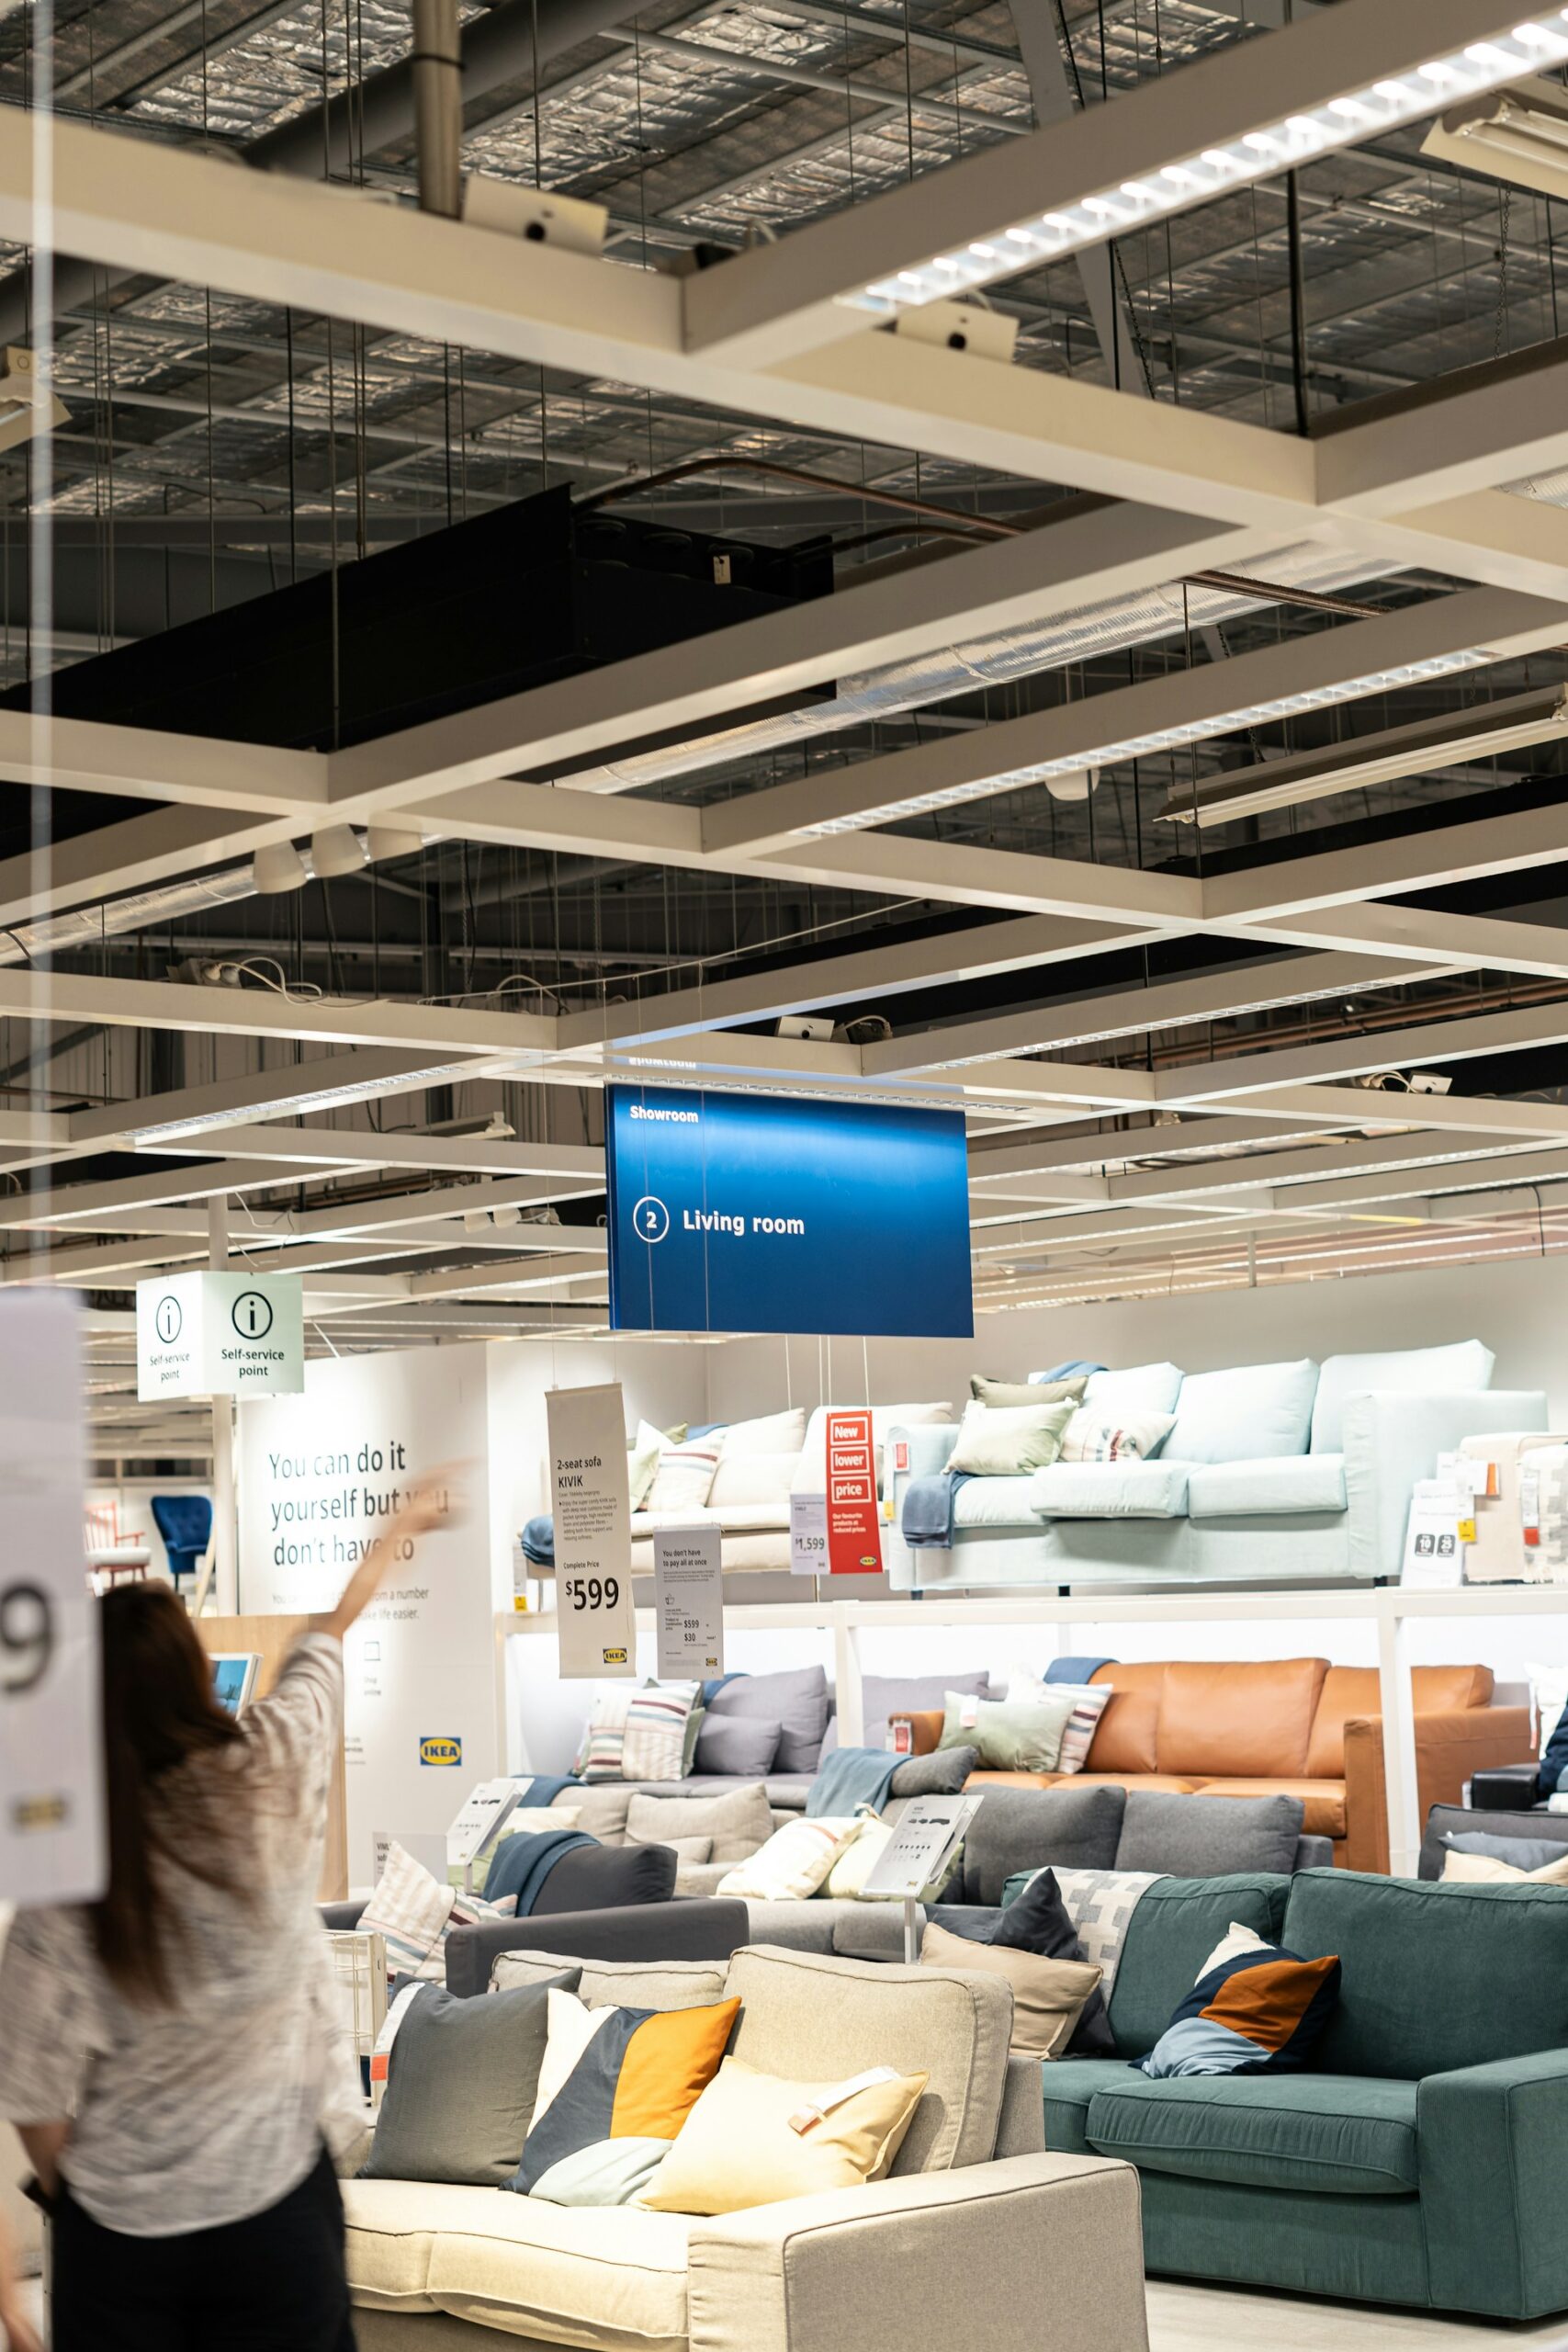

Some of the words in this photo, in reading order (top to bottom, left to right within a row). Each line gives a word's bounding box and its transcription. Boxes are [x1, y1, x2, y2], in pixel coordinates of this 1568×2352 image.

[630, 1106, 698, 1123] Showroom
[646, 1212, 657, 1229] 2
[683, 1210, 744, 1236] Living
[753, 1217, 805, 1235] room
[150, 1353, 190, 1366] Self-service
[221, 1349, 285, 1360] Self-service
[161, 1369, 180, 1383] point
[239, 1365, 268, 1378] point
[835, 1426, 858, 1439] New
[269, 1453, 305, 1479] You
[314, 1453, 349, 1476] can
[358, 1443, 383, 1473] do
[391, 1440, 406, 1470] it
[557, 1459, 582, 1470] 2-seat
[584, 1456, 601, 1467] sofa
[835, 1453, 863, 1466] lower
[558, 1476, 583, 1488] KIVIK
[836, 1483, 862, 1499] price
[272, 1488, 357, 1532] yourself
[364, 1487, 400, 1517] but
[275, 1537, 324, 1566] don't
[394, 1535, 414, 1560] to
[795, 1537, 825, 1551] $1,599
[563, 1562, 586, 1570] Complete
[397, 1587, 429, 1600] number
[566, 1577, 619, 1611] $599
[393, 1608, 420, 1620] easier.
[684, 1619, 699, 1628] $599
[684, 1633, 696, 1642] $30
[424, 1746, 458, 1756] IKEA
